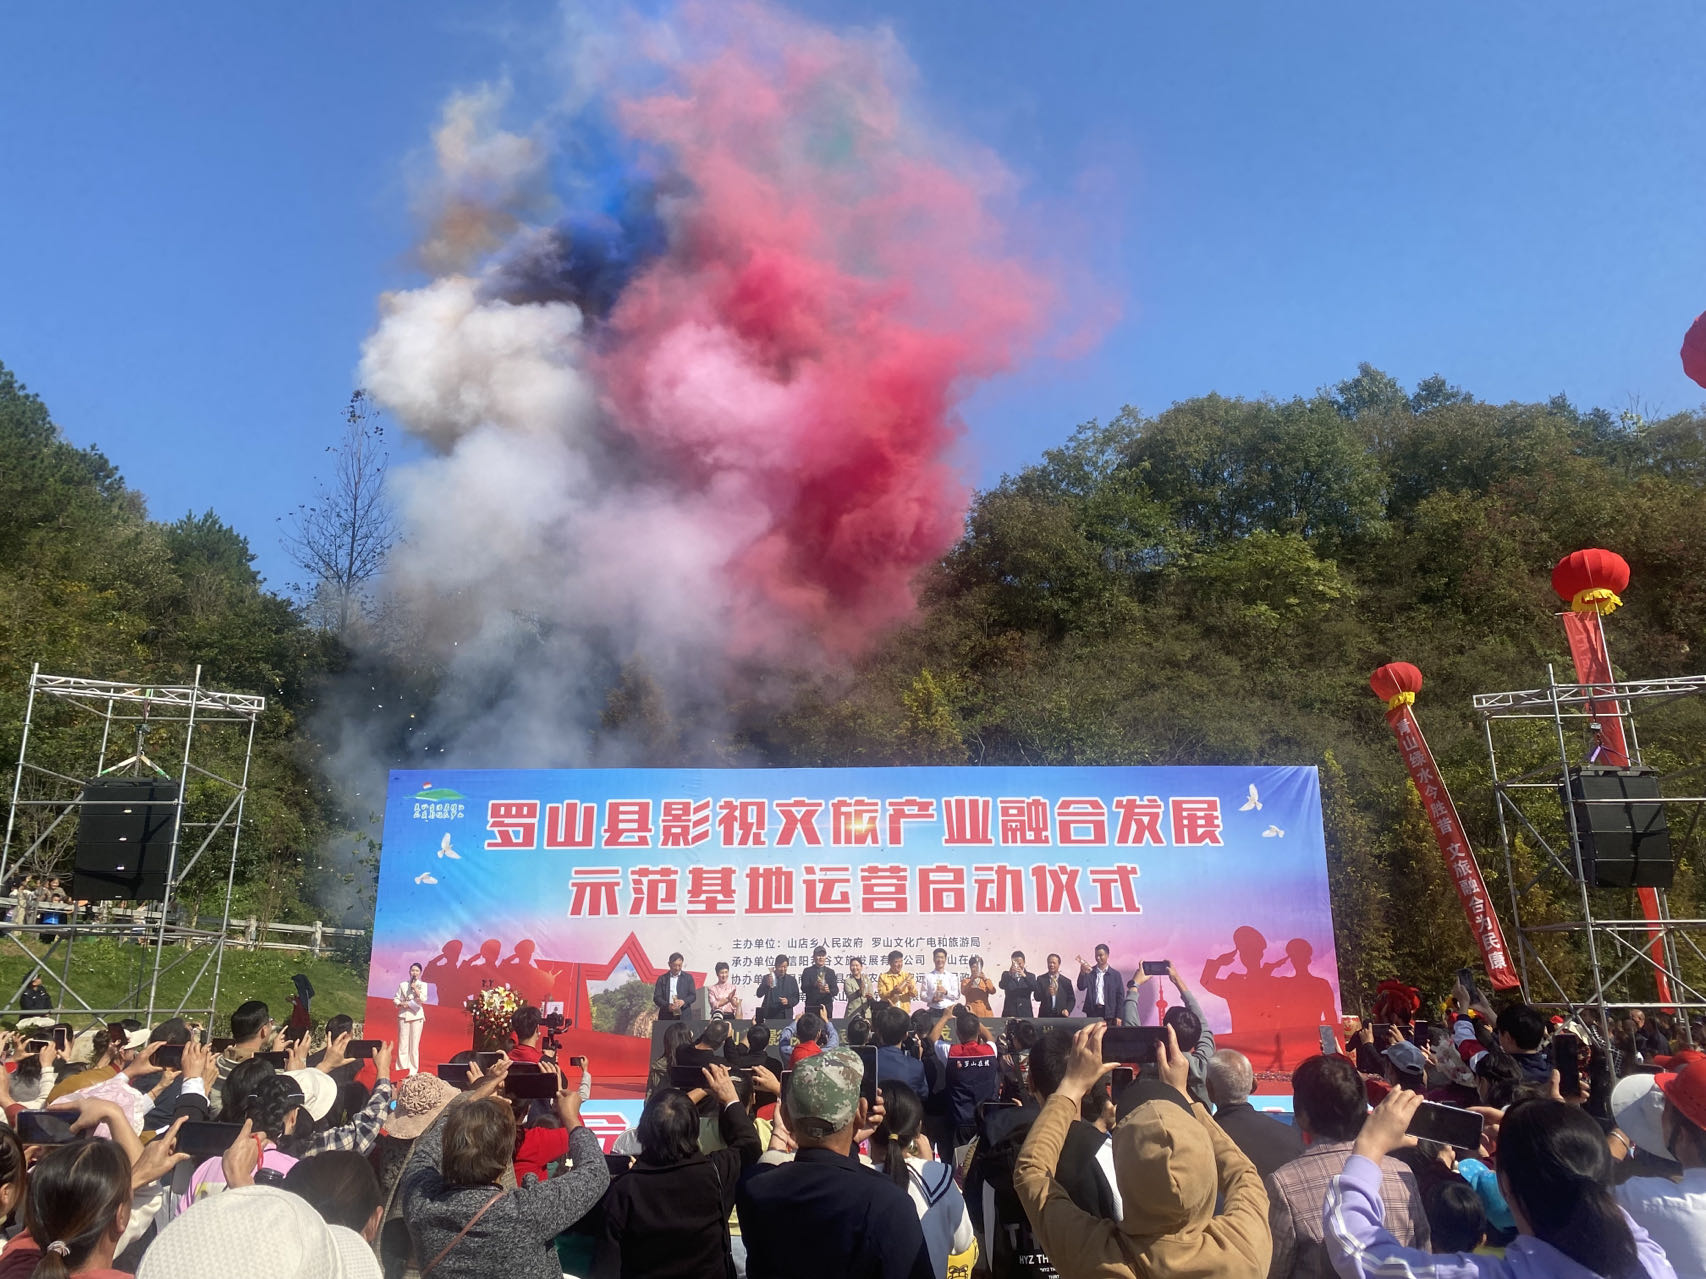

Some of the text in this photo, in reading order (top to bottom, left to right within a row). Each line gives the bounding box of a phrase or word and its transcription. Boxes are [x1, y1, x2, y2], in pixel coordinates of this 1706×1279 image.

[1397, 718, 1452, 835] 青山绿水今胜昔
[485, 797, 1224, 849] 罗山县影视文旅产业融合发展
[569, 864, 1143, 916] 示范基地运营启动仪式
[871, 937, 981, 948] 罗山文化广电和旅游局
[1036, 1254, 1049, 1264] TH
